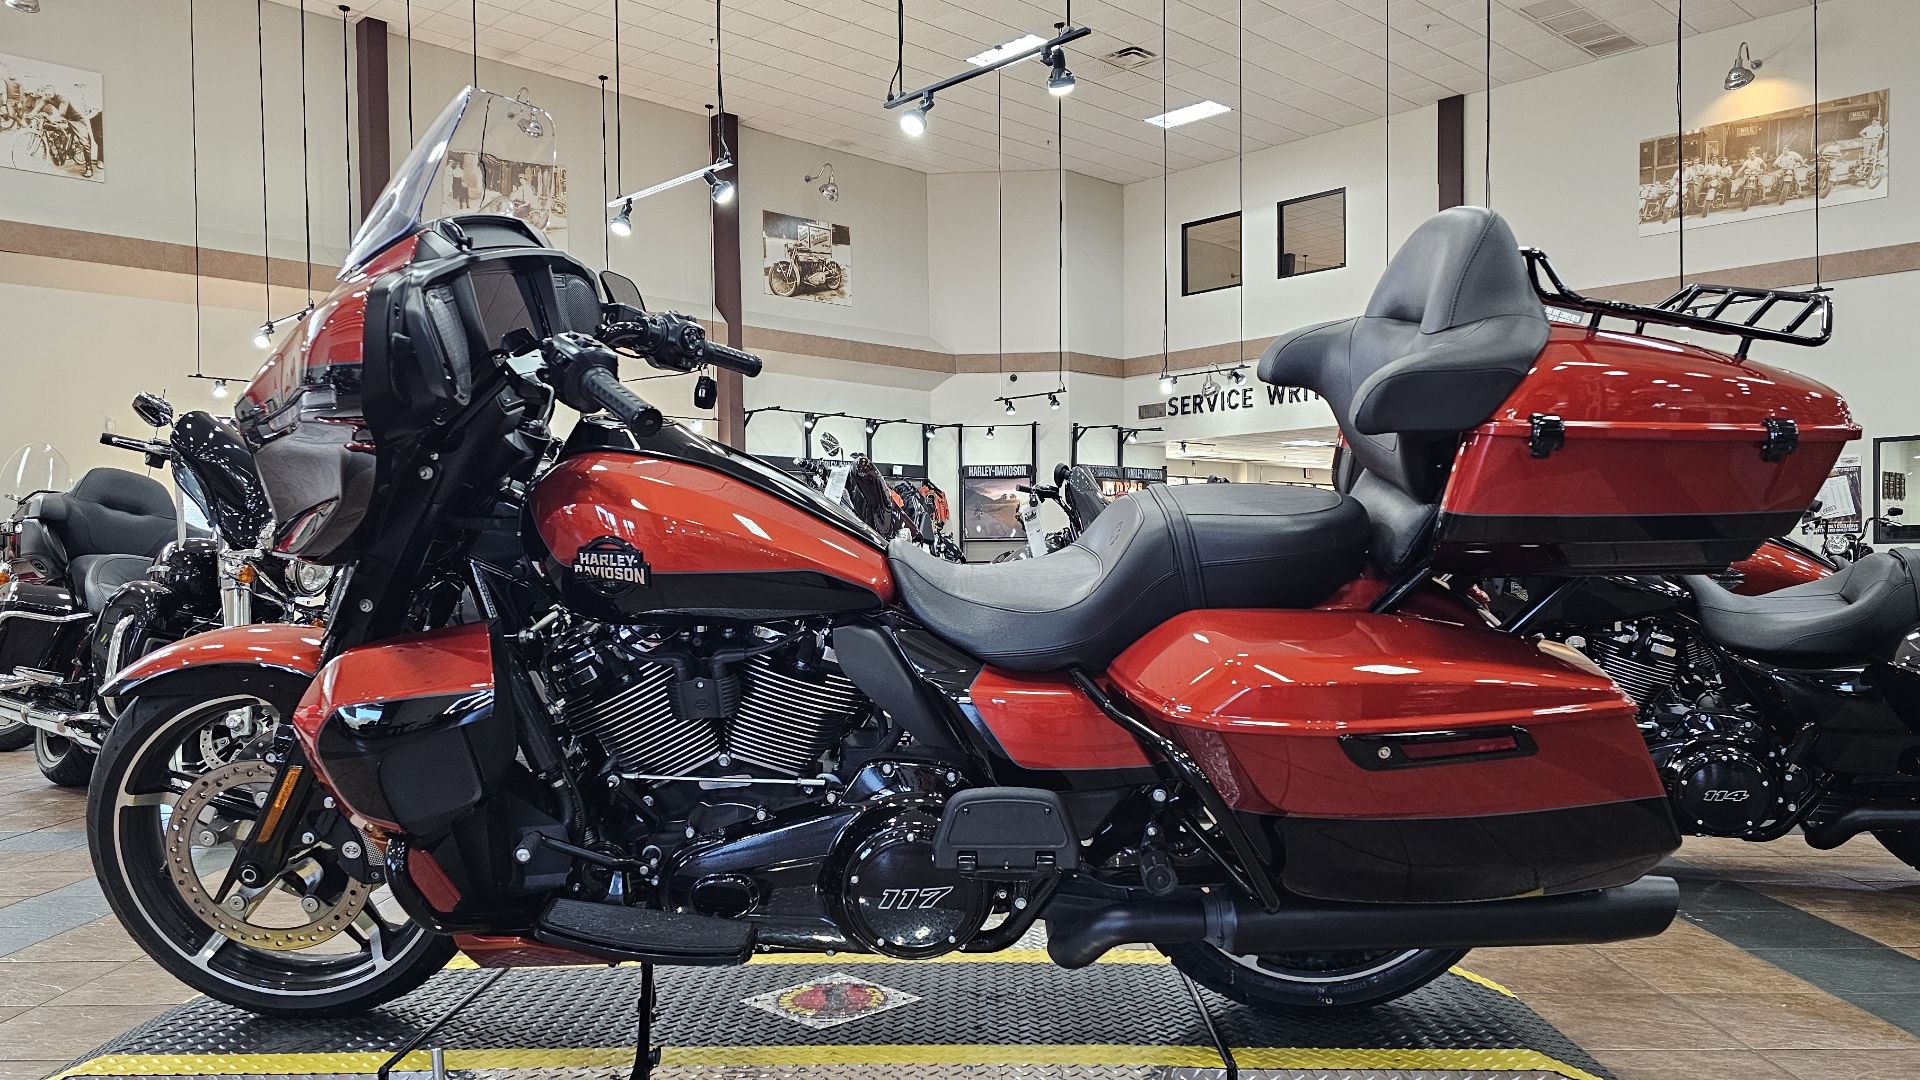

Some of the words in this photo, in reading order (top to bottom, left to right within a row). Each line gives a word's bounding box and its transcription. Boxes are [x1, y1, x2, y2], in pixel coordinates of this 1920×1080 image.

[1168, 388, 1253, 416] SERVICE
[968, 465, 1028, 477] HARLEY-DAVIDSON
[579, 553, 637, 566] HARLEY-
[574, 565, 645, 584] DAVIDSON
[1703, 790, 1750, 801] 114
[878, 886, 954, 910] 117
